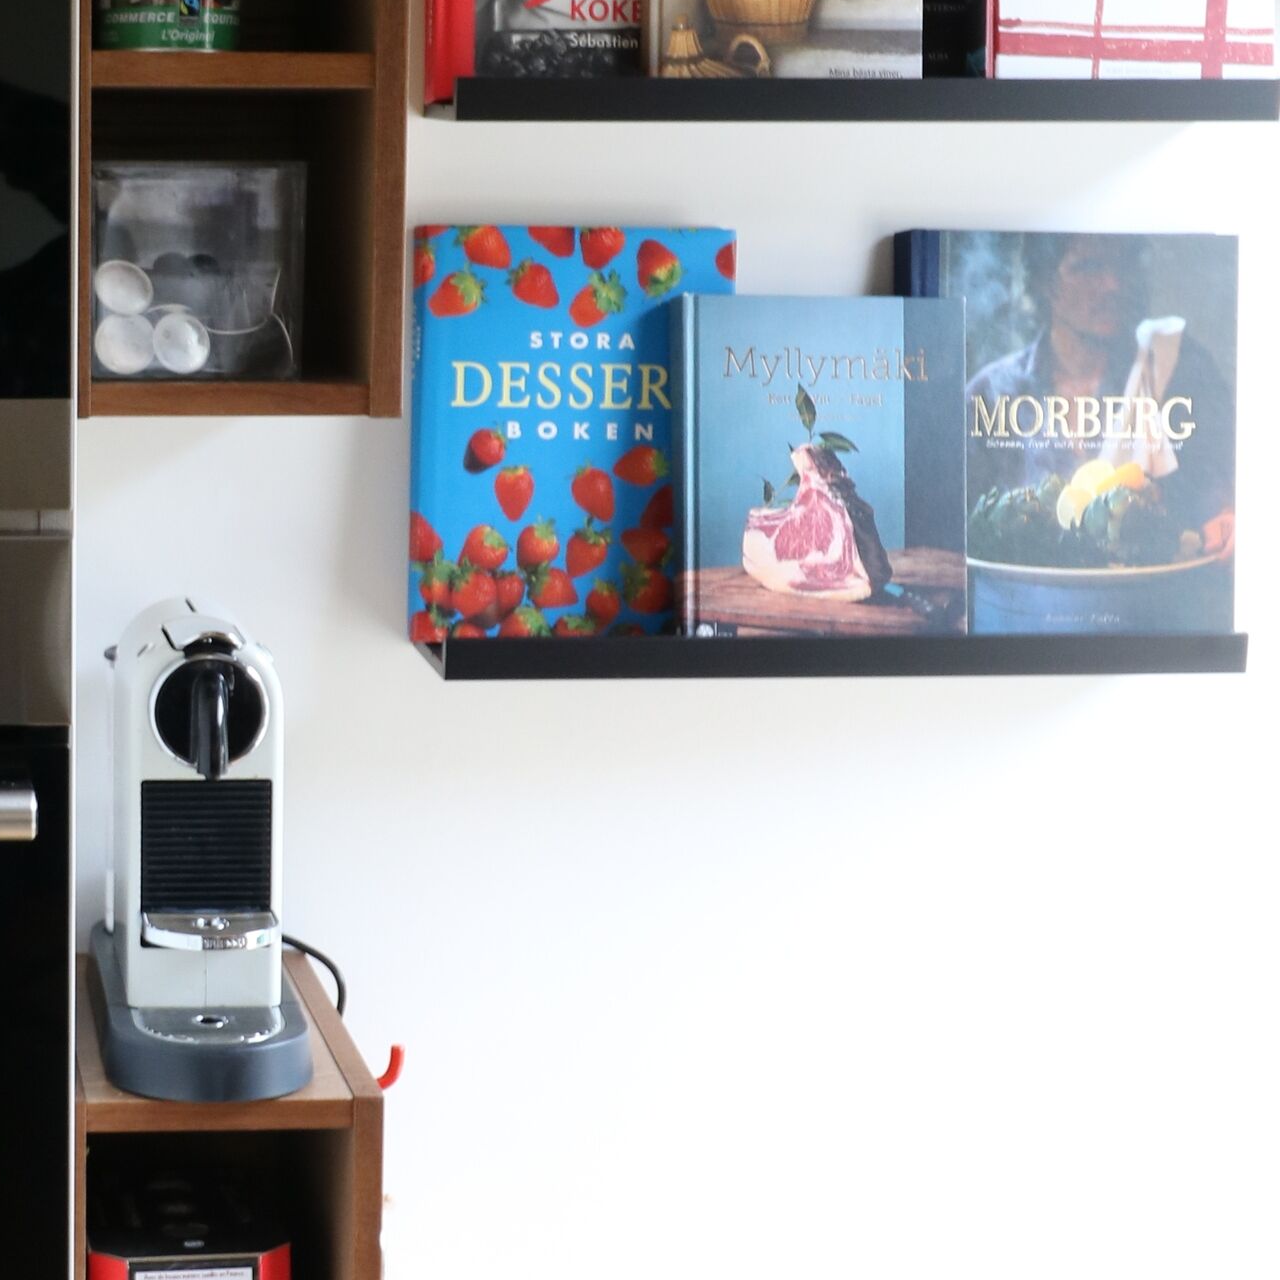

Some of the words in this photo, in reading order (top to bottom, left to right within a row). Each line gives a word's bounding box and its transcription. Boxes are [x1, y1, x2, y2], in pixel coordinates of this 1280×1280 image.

[530, 331, 635, 350] STORA
[450, 360, 672, 410] DESSER
[723, 346, 929, 387] Myllymäki
[506, 421, 654, 441] BOKEN
[971, 395, 1197, 440] MORBERG
